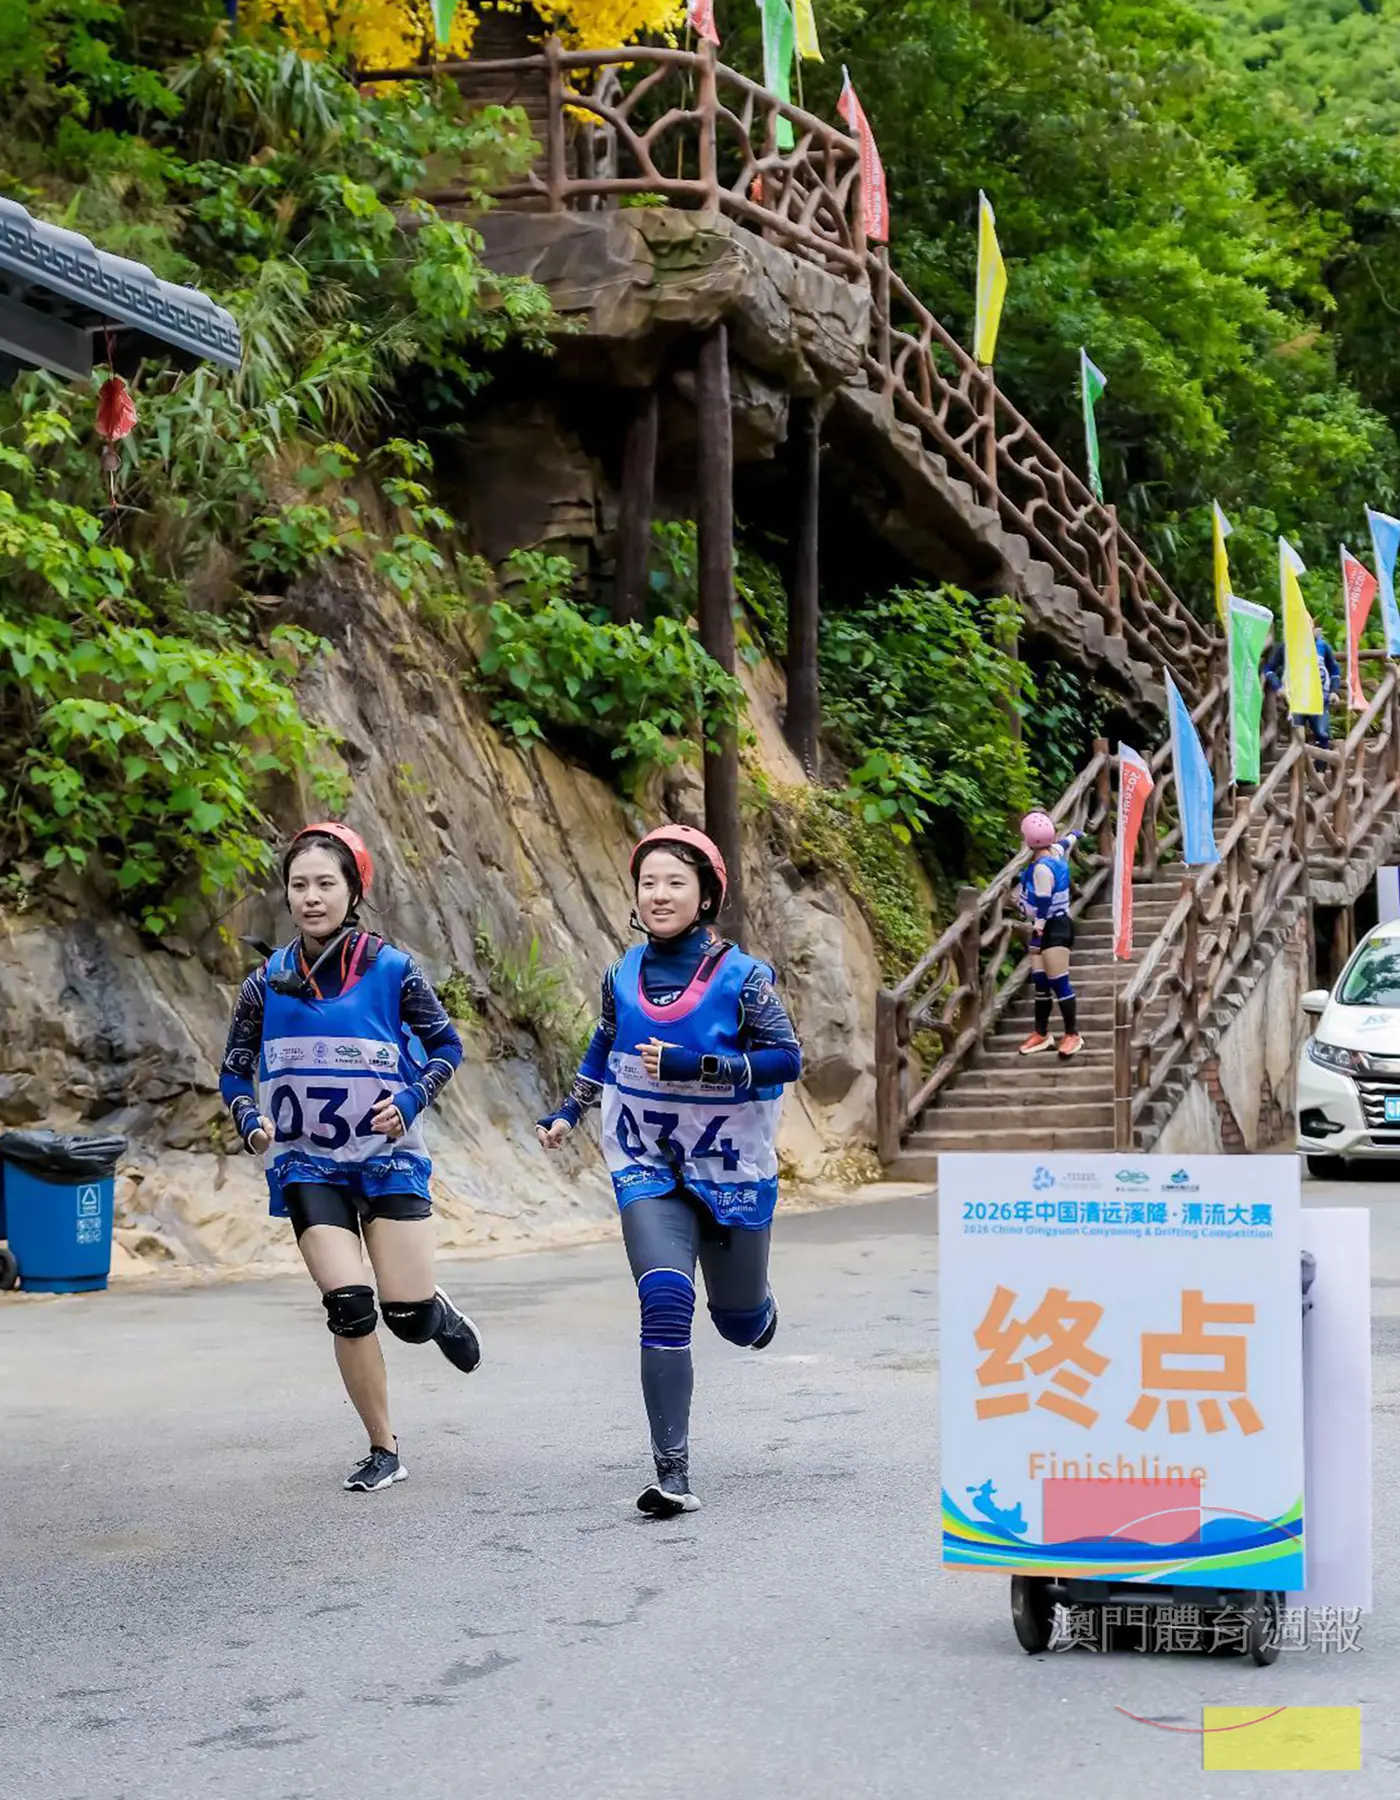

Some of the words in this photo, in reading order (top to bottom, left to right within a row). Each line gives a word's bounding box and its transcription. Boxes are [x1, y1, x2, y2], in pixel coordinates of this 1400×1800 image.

[615, 1103, 740, 1172] 034
[963, 1224, 990, 1234] 2026
[992, 1224, 1023, 1235] China
[1144, 1227, 1152, 1237] &
[1155, 1227, 1198, 1239] Drifting
[1201, 1227, 1273, 1239] Competition
[974, 1285, 1265, 1437] 终点
[1027, 1451, 1209, 1489] Finishline
